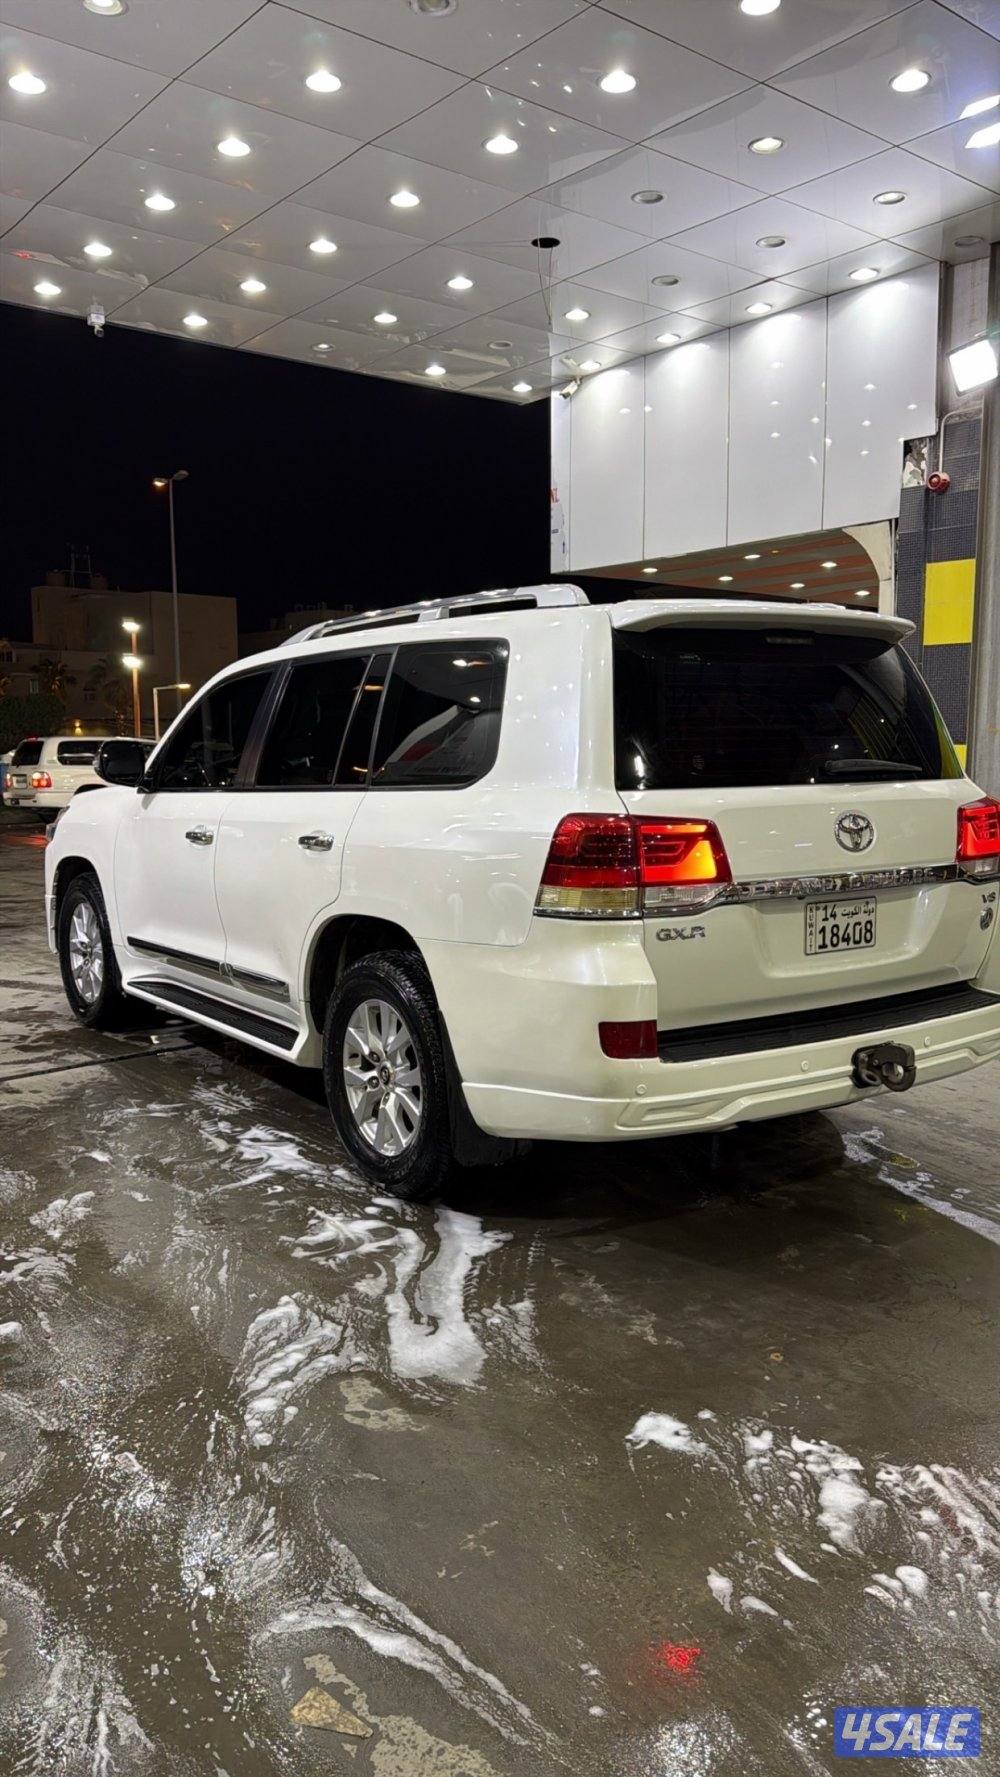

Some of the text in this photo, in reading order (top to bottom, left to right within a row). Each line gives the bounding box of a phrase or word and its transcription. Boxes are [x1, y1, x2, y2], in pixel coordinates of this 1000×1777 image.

[822, 904, 837, 921] 14
[841, 905, 862, 919] الكويت
[818, 920, 873, 949] 18408
